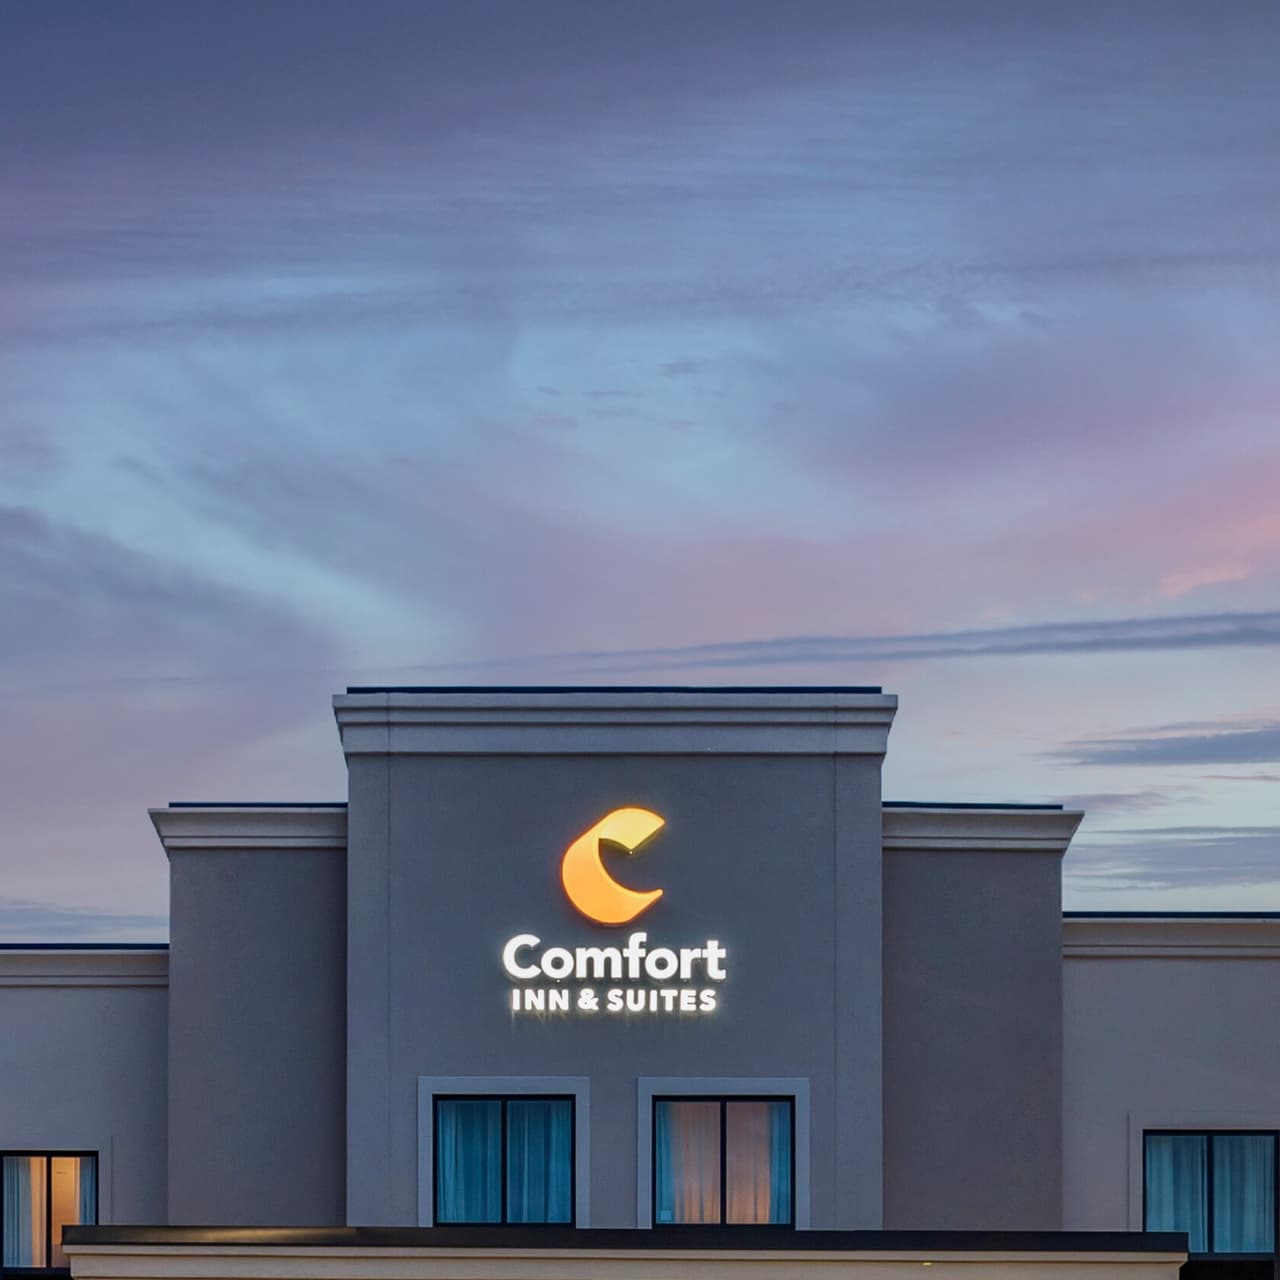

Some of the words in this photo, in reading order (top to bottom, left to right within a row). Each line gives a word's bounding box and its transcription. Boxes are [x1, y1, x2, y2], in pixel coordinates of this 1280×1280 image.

[502, 931, 727, 980] Comfort
[512, 988, 569, 1011] INN
[577, 988, 599, 1011] &
[606, 988, 717, 1012] SUITES
